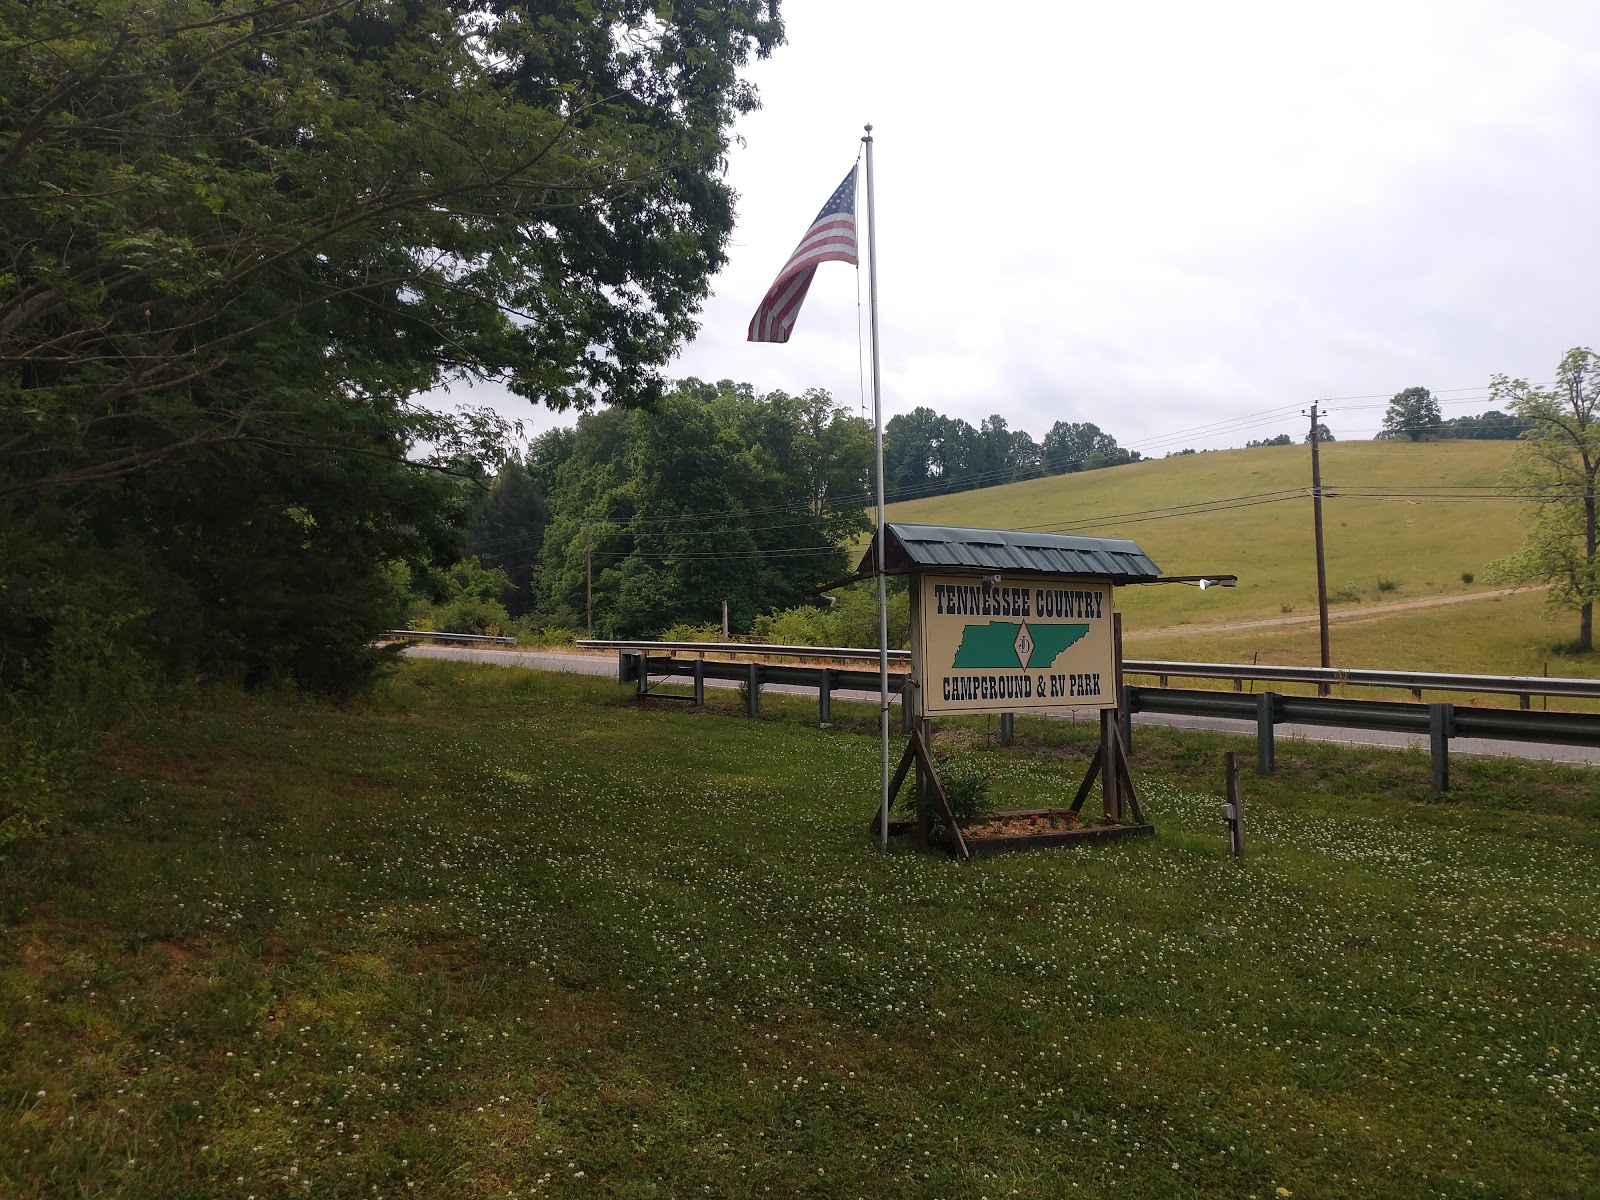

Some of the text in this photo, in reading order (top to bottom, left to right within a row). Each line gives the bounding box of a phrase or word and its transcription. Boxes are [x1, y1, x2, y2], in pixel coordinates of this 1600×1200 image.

[934, 584, 1103, 619] TENNESSEE COUNTRY
[942, 673, 1101, 701] CAMPGROUND & RV PARK
